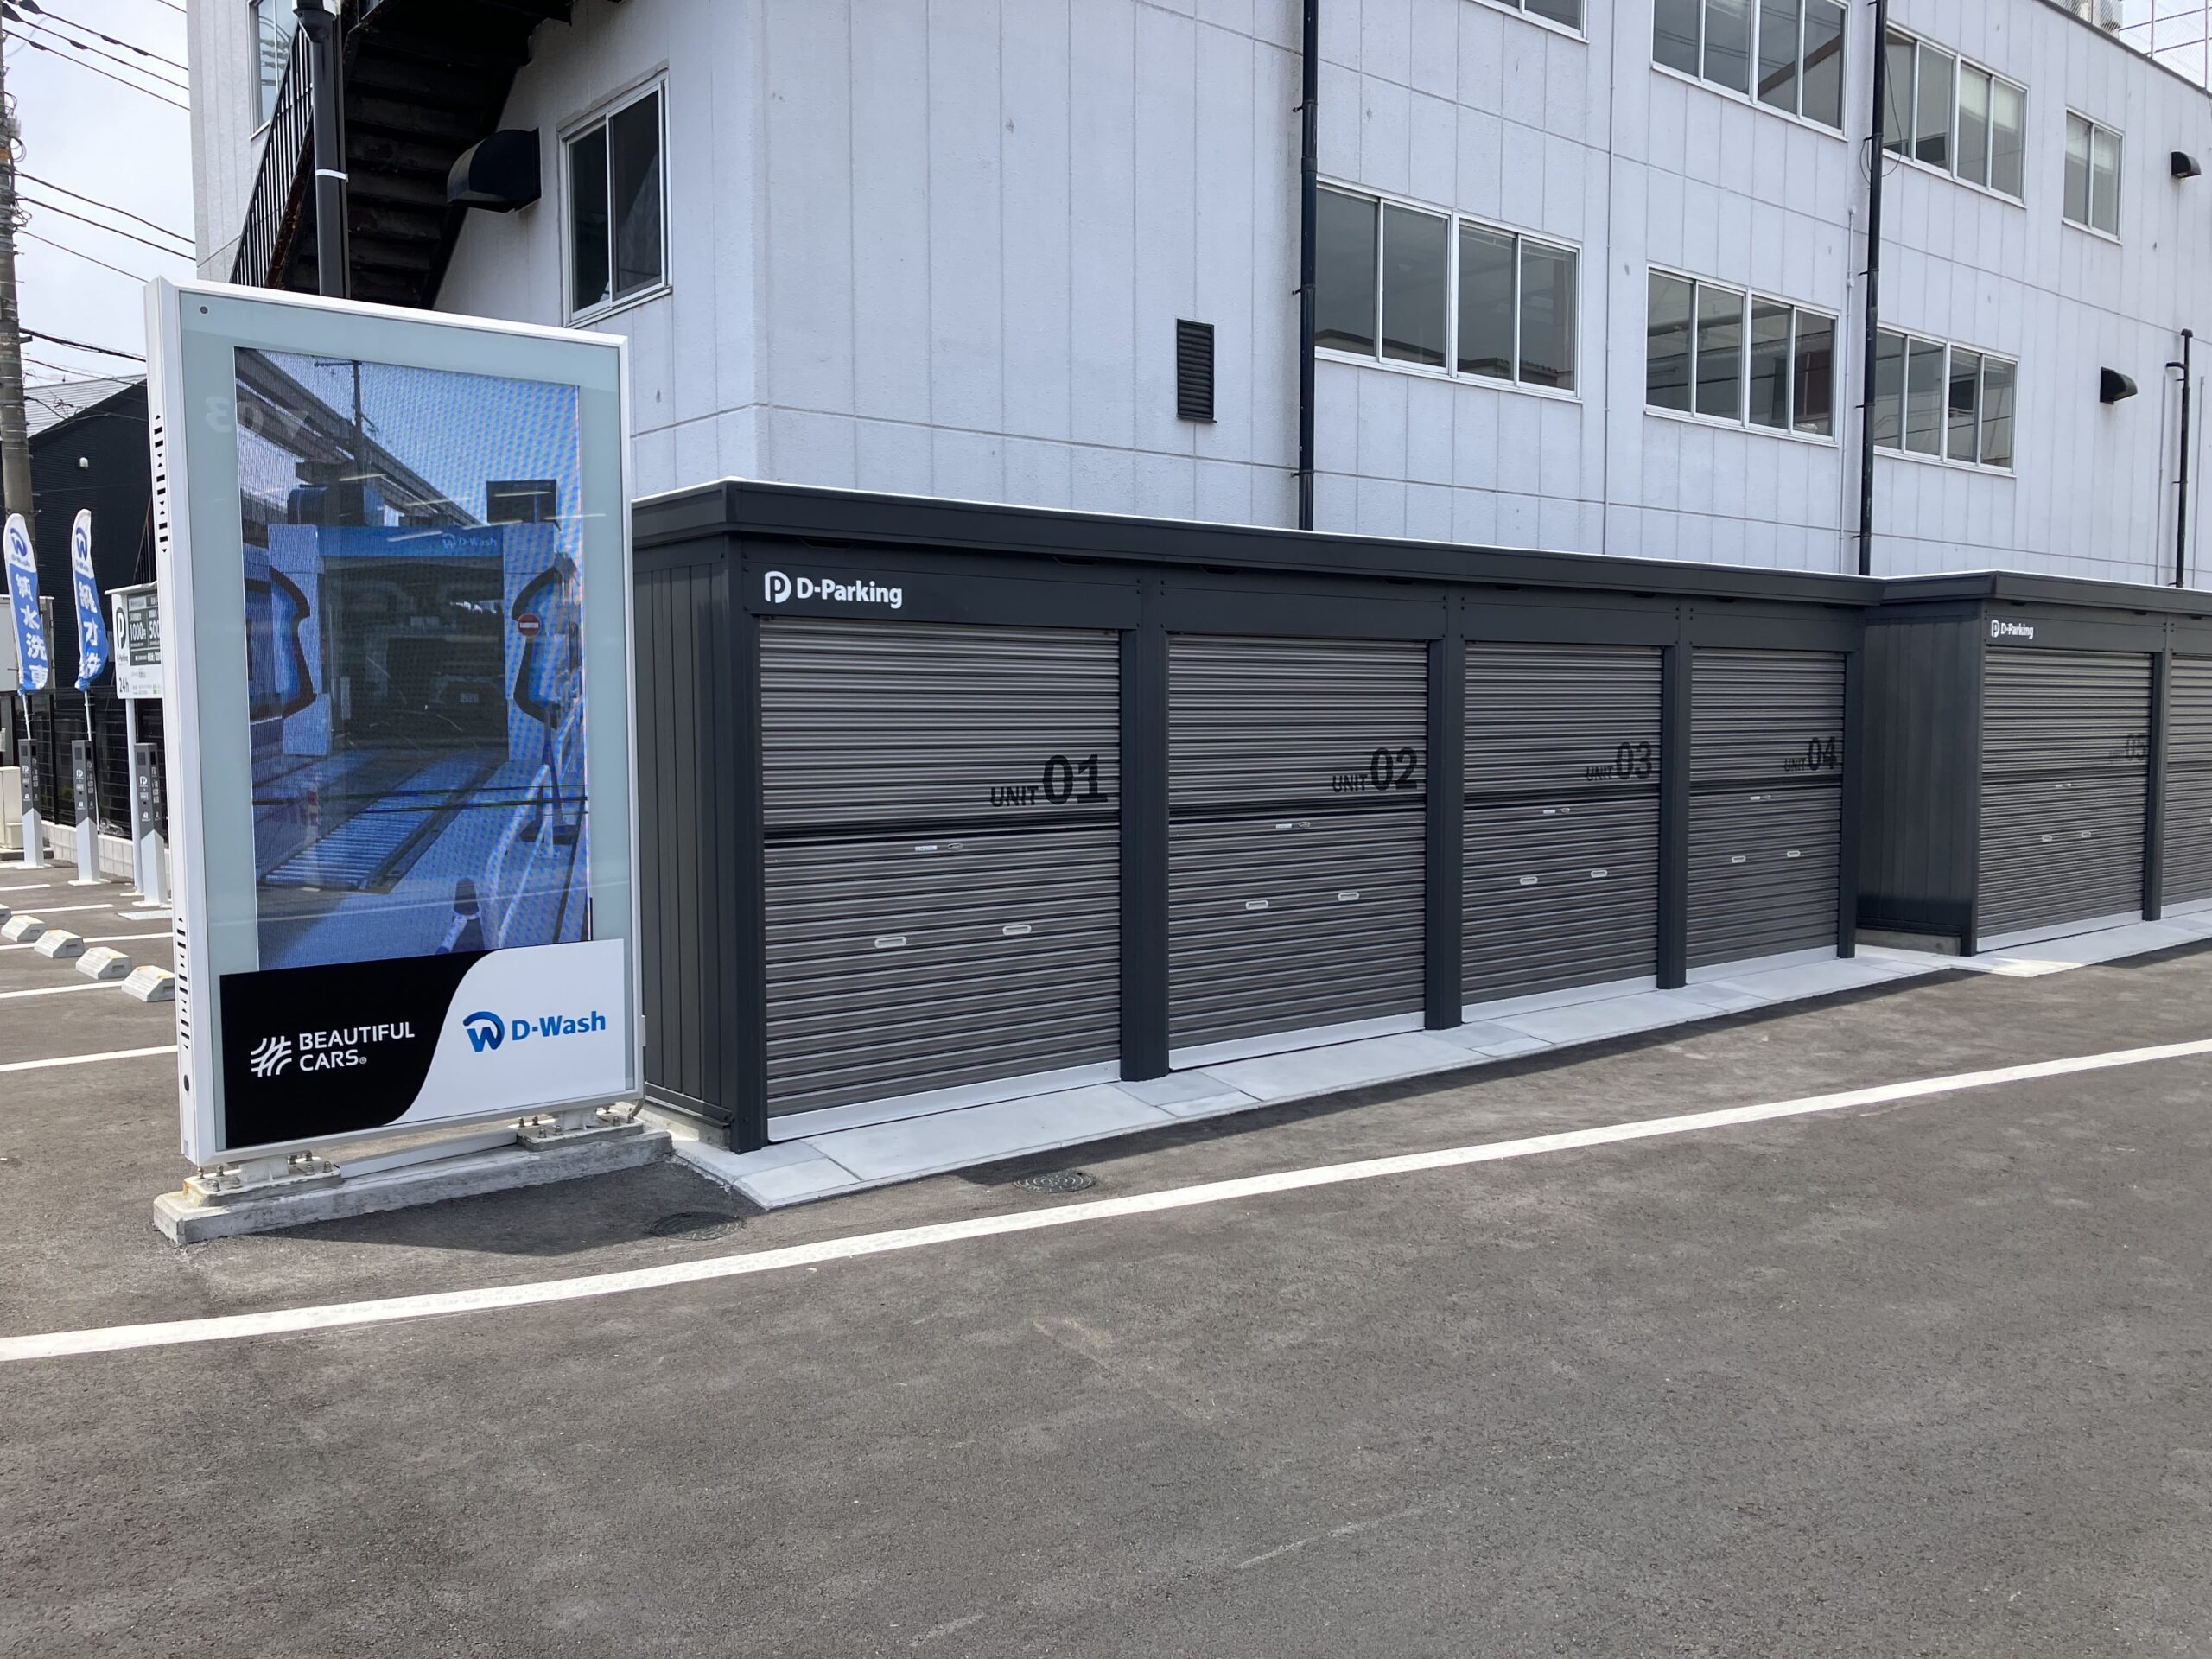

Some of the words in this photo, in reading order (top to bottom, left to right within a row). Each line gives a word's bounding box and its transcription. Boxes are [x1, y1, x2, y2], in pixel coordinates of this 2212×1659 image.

[797, 577, 903, 609] D-Parking
[2000, 622, 2034, 639] D-Parking
[1332, 773, 1368, 793] UNIT
[1370, 747, 1417, 791] 02
[1616, 741, 1652, 780] 03
[1808, 735, 1838, 772] 04
[989, 785, 1039, 807] UNIT
[1042, 753, 1109, 805] 01
[298, 1021, 415, 1052] BEAUTIFUL
[511, 1010, 606, 1042] D-Wash
